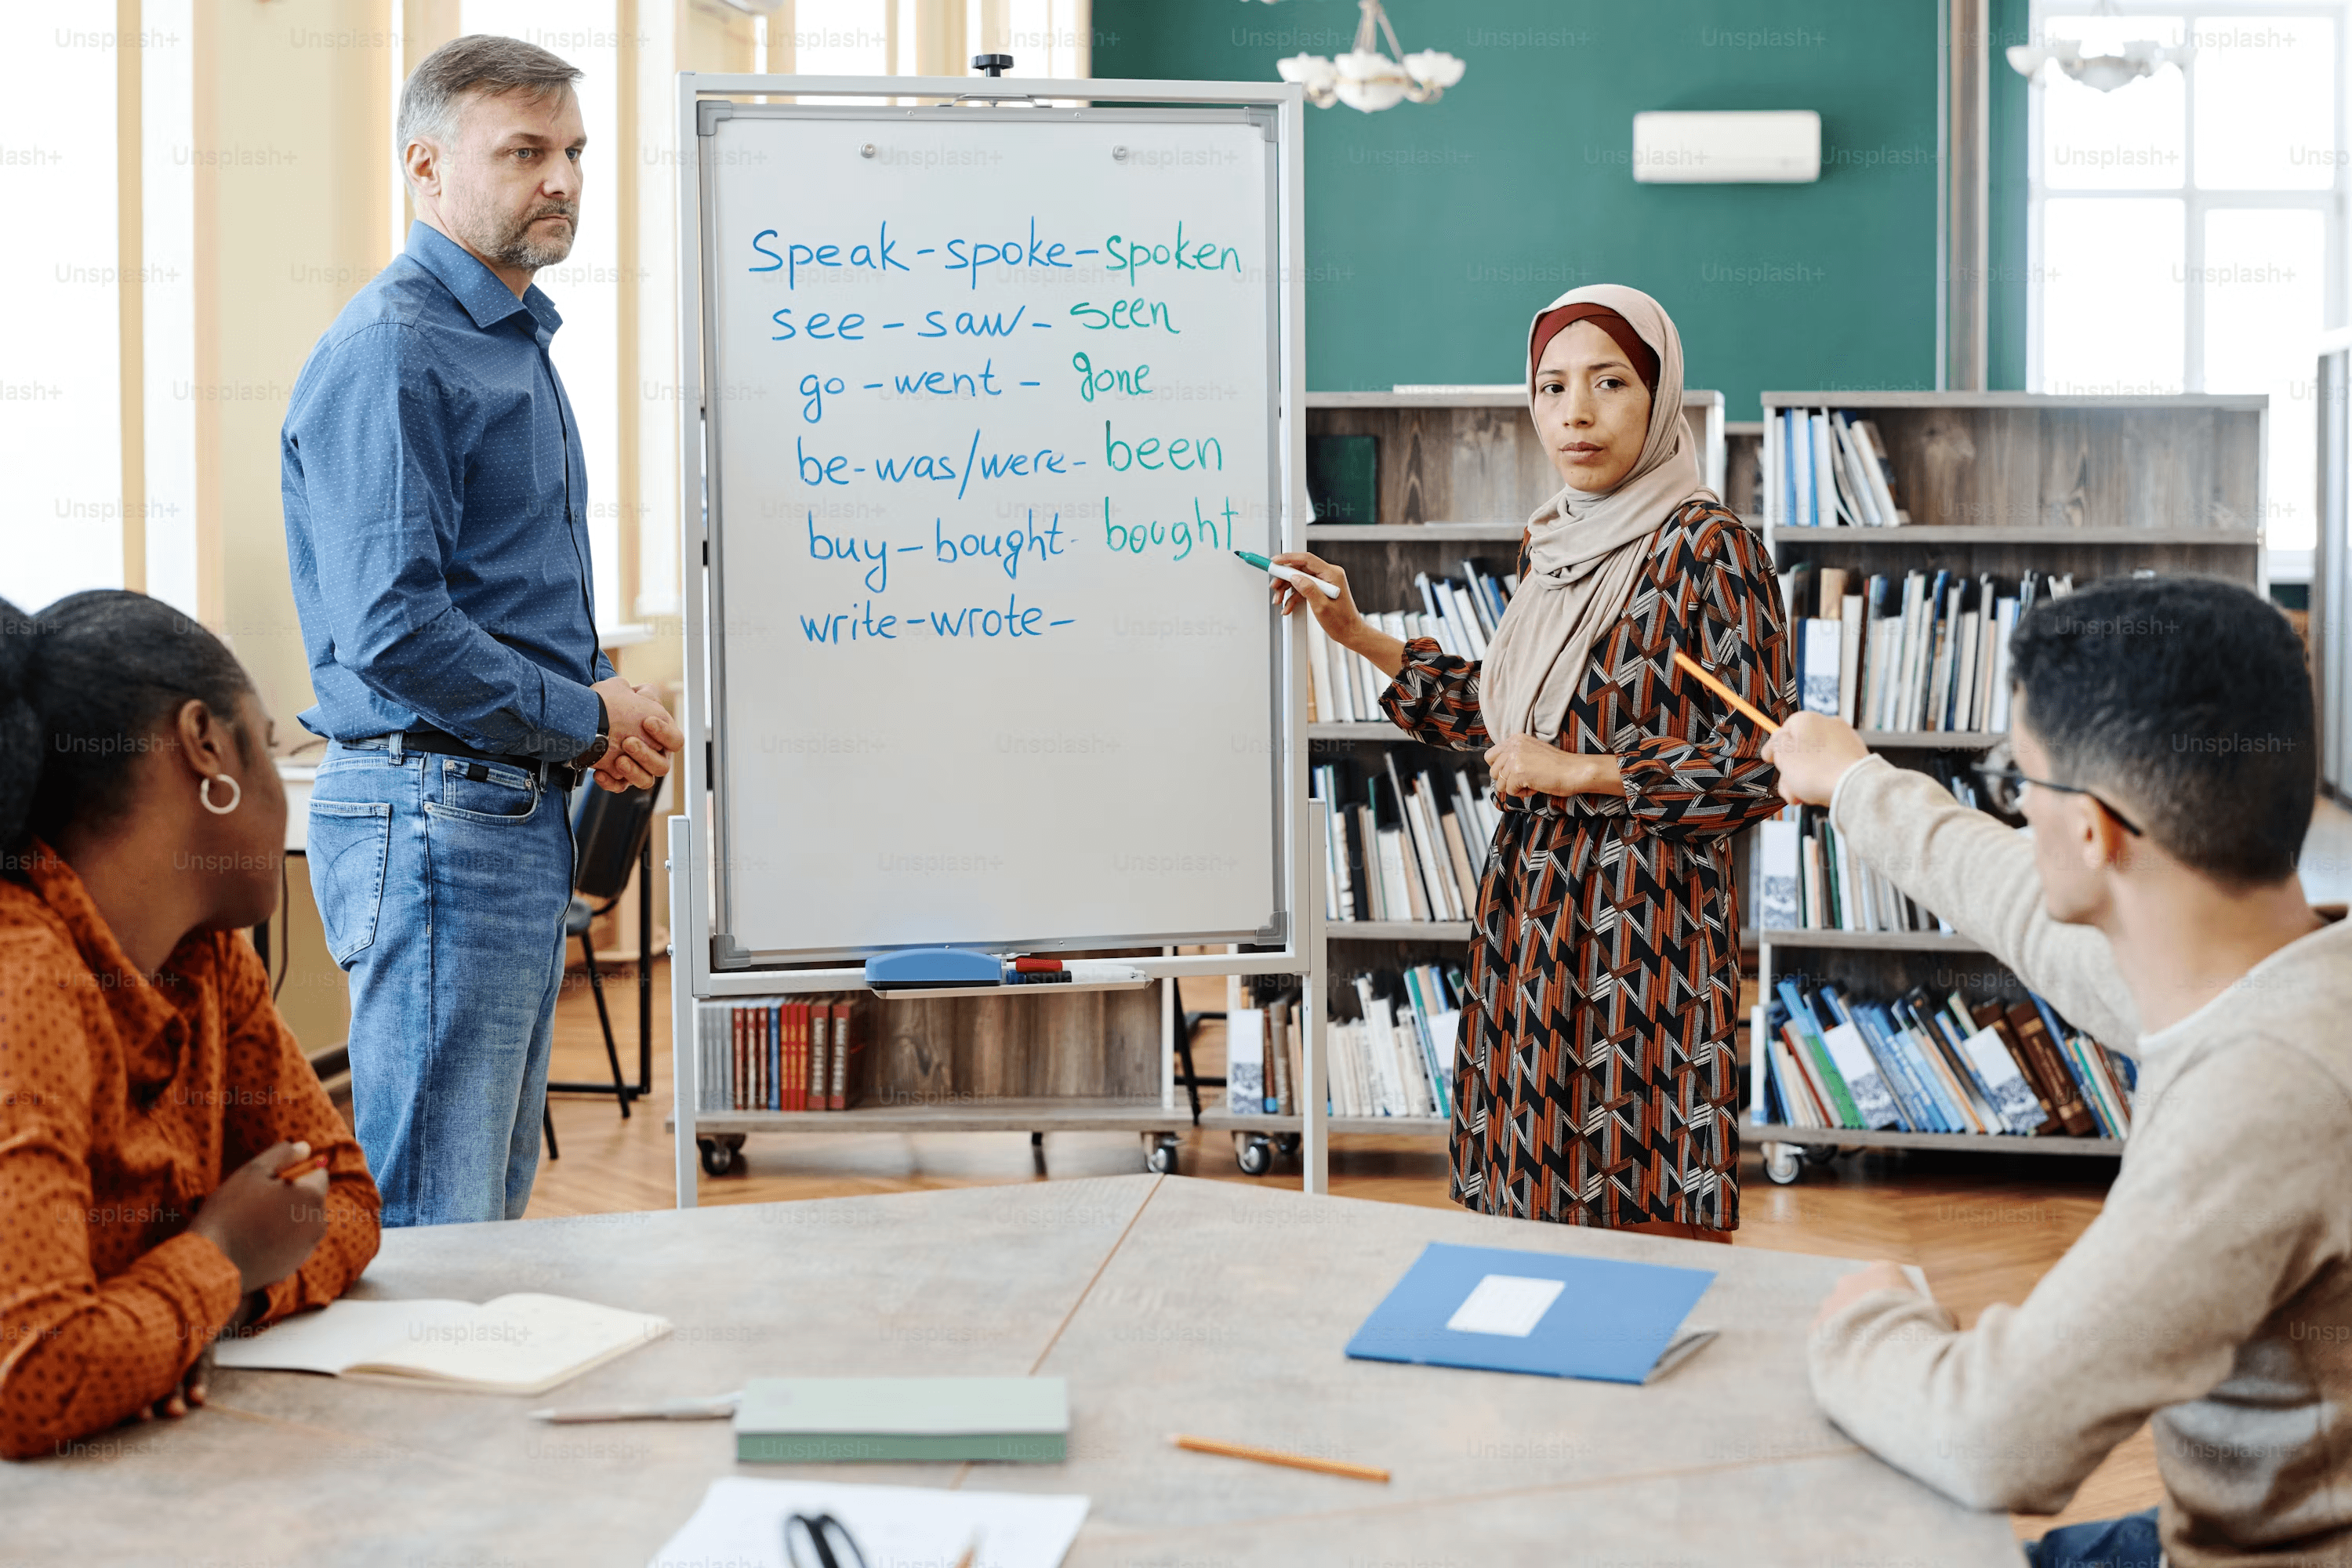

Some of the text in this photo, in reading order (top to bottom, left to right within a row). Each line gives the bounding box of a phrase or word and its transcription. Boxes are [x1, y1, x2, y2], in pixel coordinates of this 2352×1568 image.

[771, 307, 866, 342] see
[1069, 297, 1180, 335] seen
[799, 373, 845, 424] go
[1072, 351, 1153, 403] gone
[1105, 419, 1222, 472] been
[1104, 495, 1240, 562] bought
